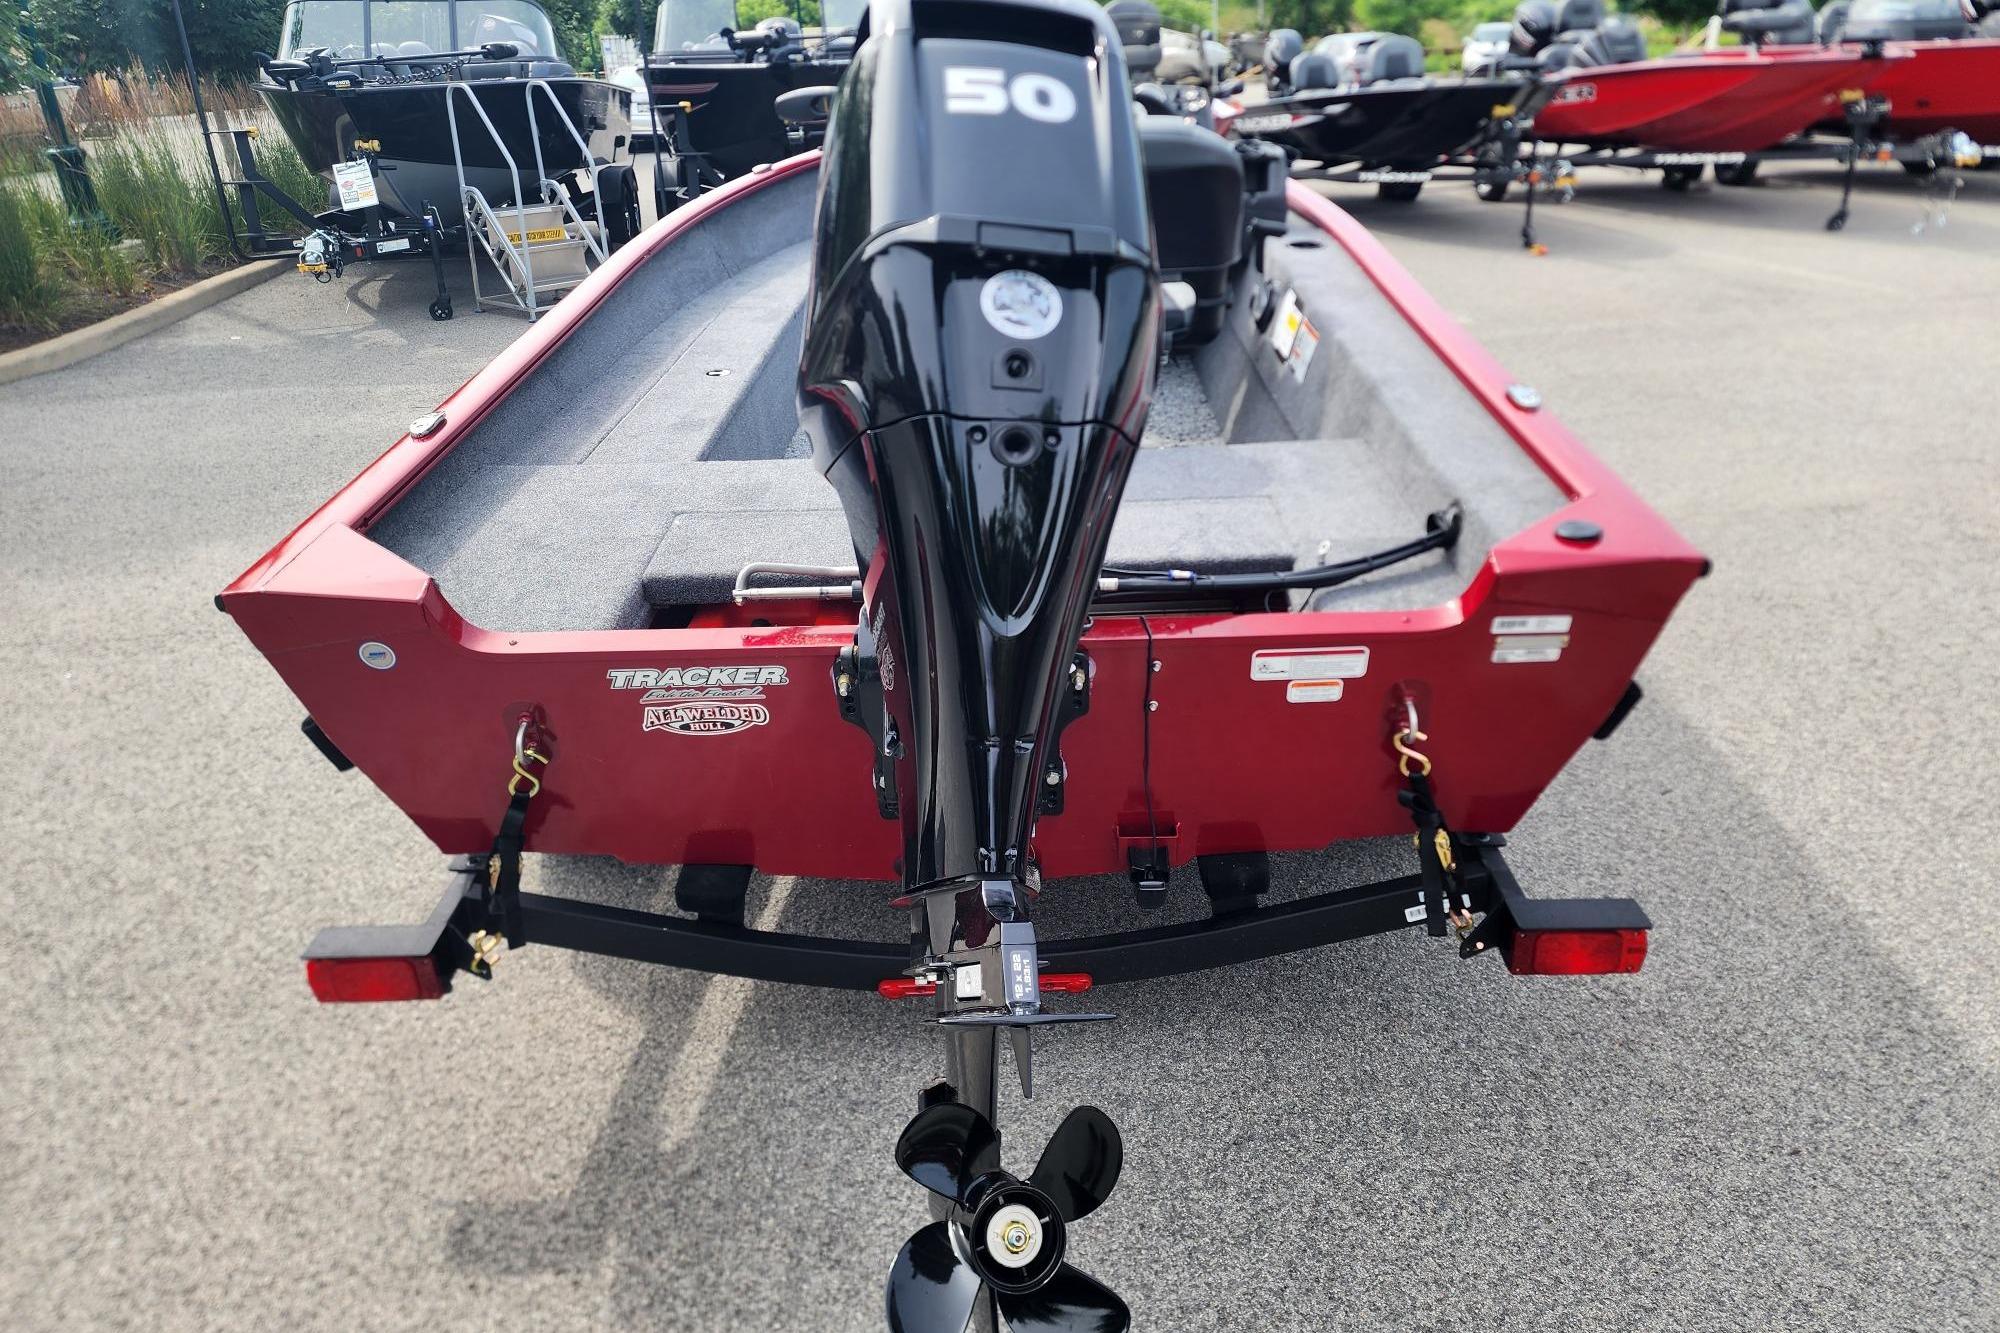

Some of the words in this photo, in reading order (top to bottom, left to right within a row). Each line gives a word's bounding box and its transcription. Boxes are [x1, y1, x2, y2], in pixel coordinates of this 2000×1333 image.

[944, 66, 1077, 123] 50
[646, 689, 676, 699] Fish
[679, 689, 700, 698] the
[646, 708, 684, 728] ALL
[684, 706, 766, 723] WELDED
[689, 722, 725, 731] HULL
